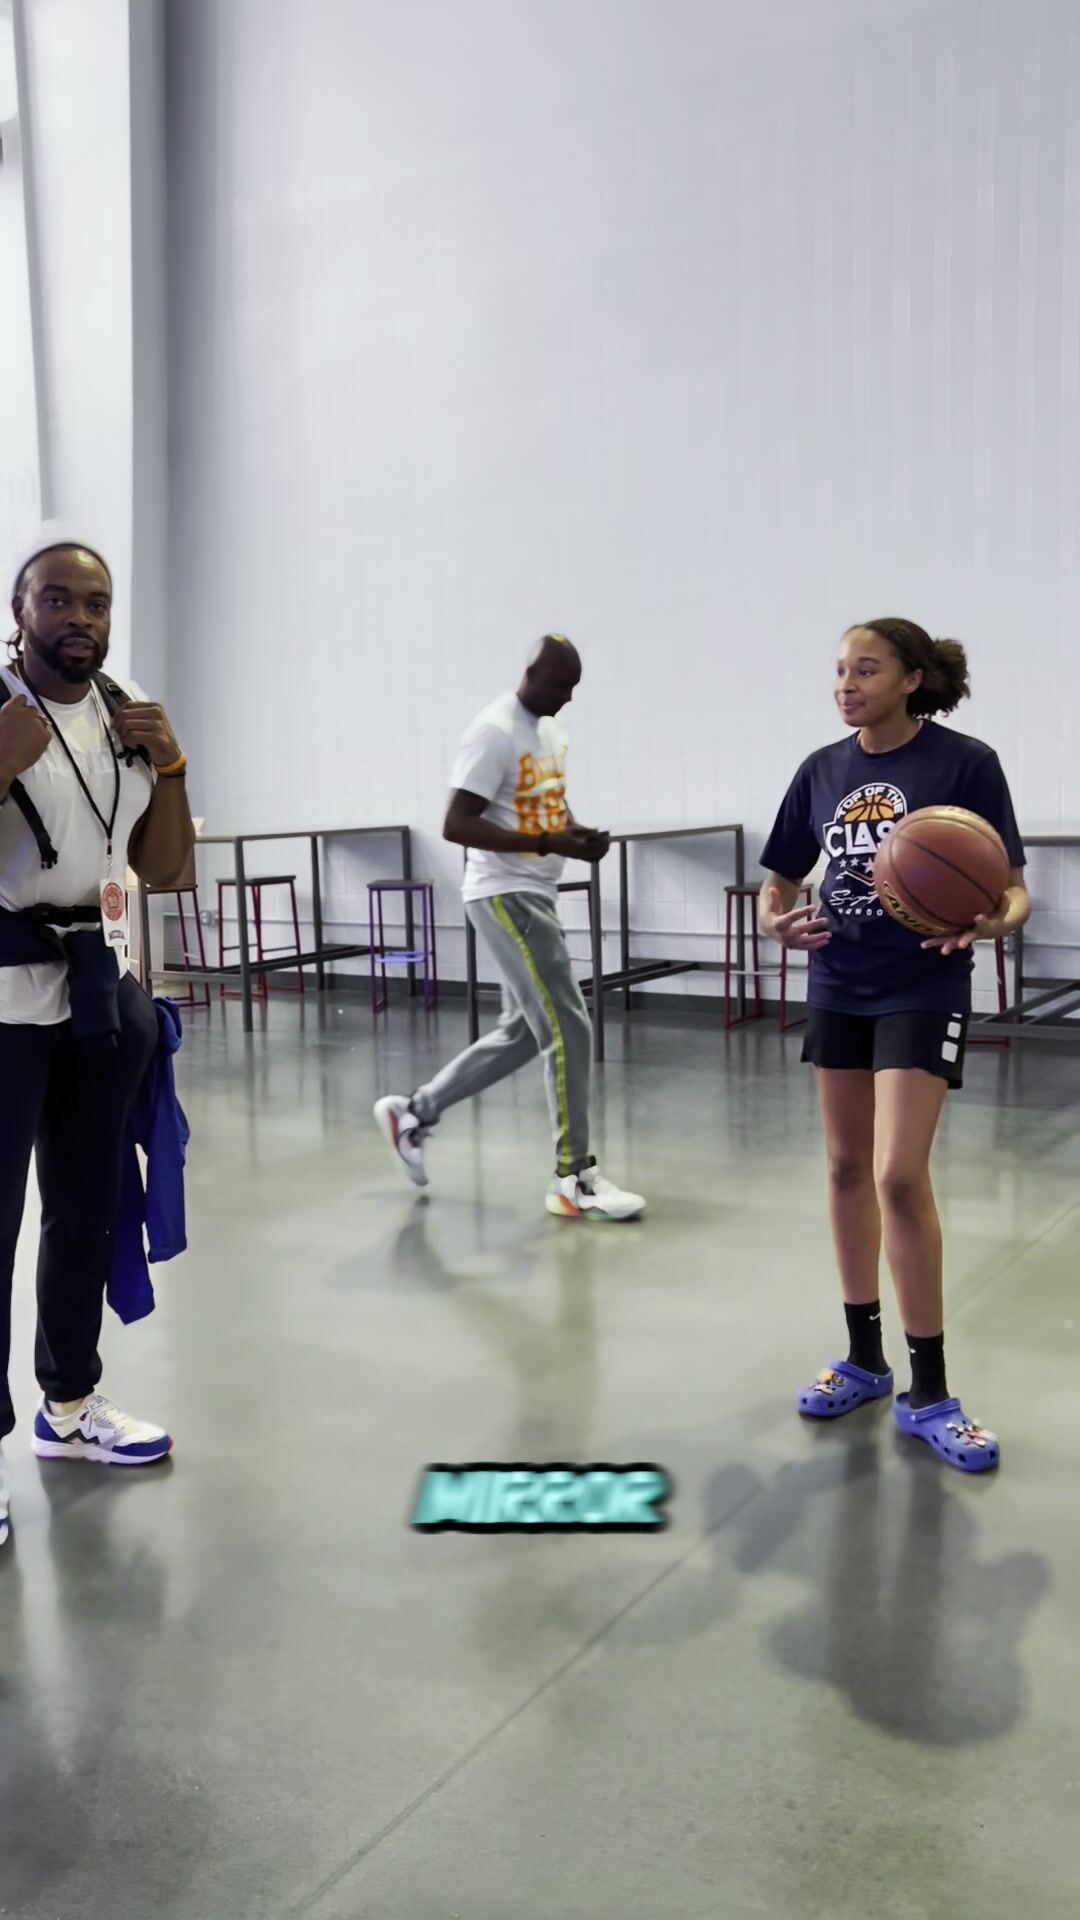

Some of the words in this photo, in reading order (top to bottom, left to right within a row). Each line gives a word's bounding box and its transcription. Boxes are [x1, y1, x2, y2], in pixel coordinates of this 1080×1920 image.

[837, 792, 862, 819] TOP
[864, 786, 885, 797] OF
[886, 788, 904, 814] THE
[825, 820, 895, 858] CLAS
